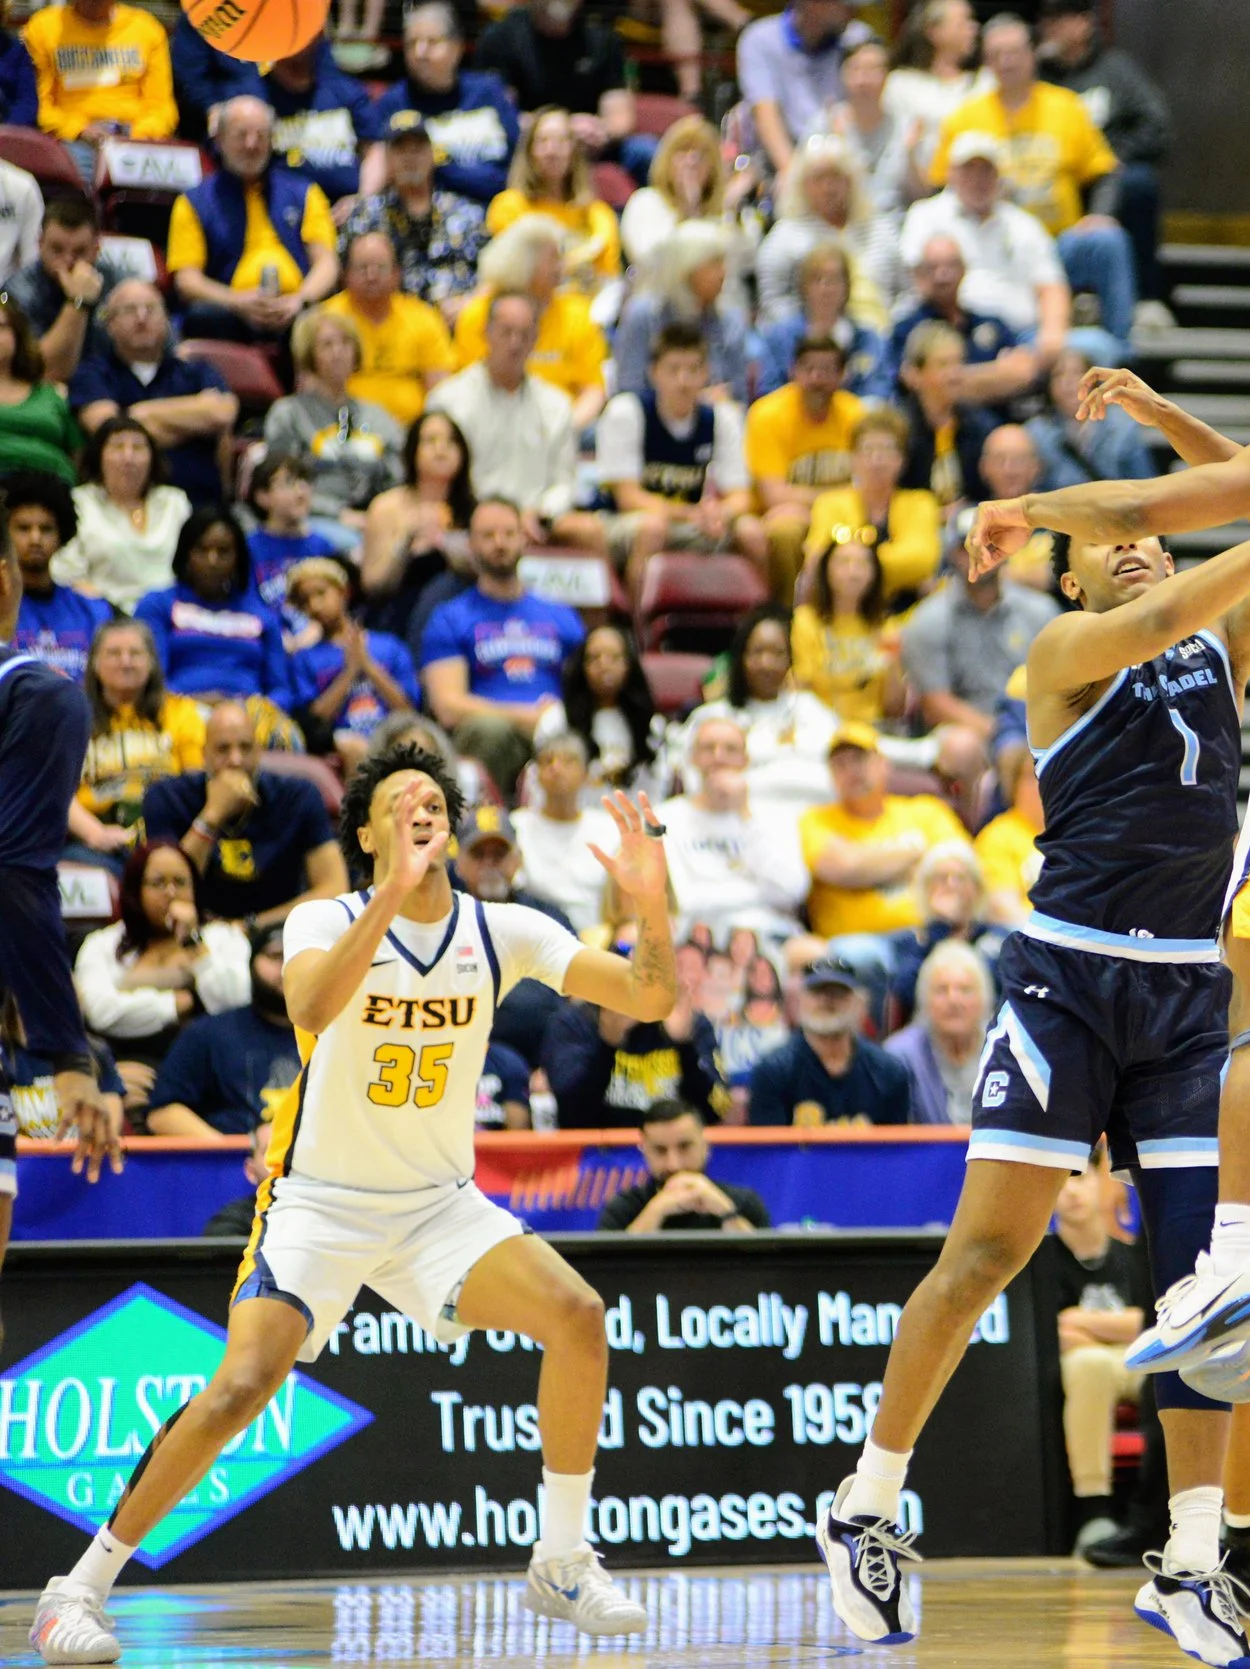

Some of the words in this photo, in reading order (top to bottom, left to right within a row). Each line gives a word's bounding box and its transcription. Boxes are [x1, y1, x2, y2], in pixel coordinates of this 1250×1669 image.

[1158, 668, 1218, 697] CADEL
[1168, 708, 1200, 786] 1
[362, 994, 477, 1031] ETSU
[367, 1041, 454, 1109] 35
[982, 1070, 1009, 1108] C
[656, 1291, 808, 1360] Locally
[817, 1290, 1009, 1346] Mand
[0, 1372, 299, 1460] HOLSTN
[431, 1387, 625, 1451] Trusd
[637, 1384, 775, 1448] Since
